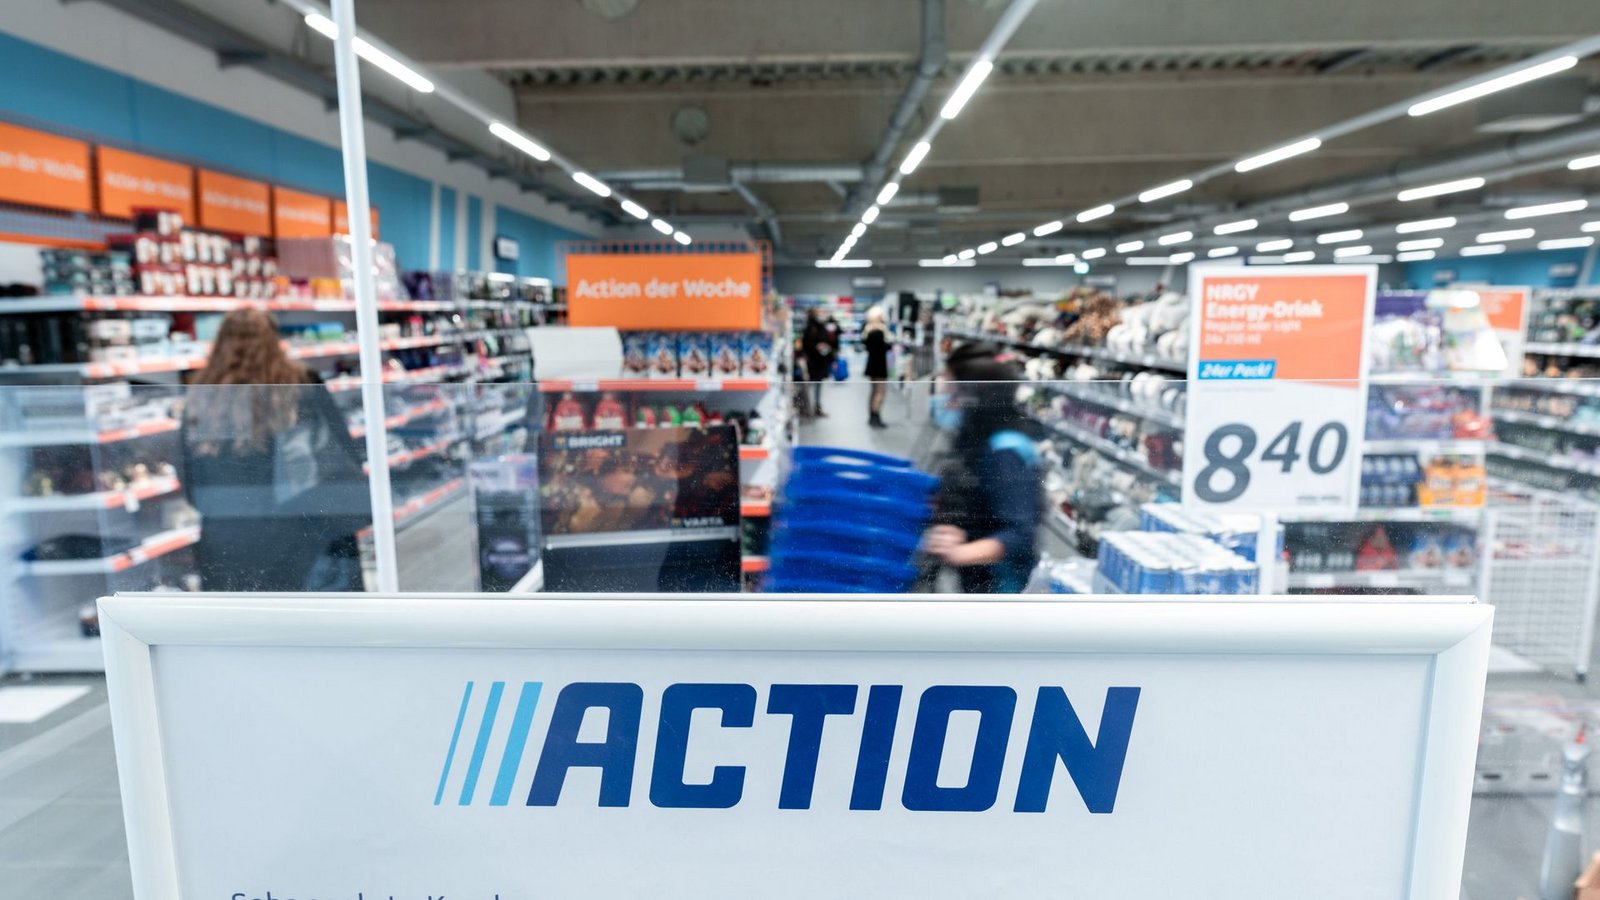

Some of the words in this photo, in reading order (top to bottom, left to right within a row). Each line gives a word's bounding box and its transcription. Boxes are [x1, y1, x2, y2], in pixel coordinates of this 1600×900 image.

[576, 278, 641, 298] Action
[645, 277, 678, 298] der
[683, 277, 751, 298] Woche
[1206, 284, 1259, 301] NRGY
[1205, 299, 1323, 321] Energy-Drink
[1200, 363, 1233, 378] 24er
[1233, 362, 1273, 378] Pack!
[568, 434, 625, 449] BRIGHT
[525, 682, 1142, 815] ACTION
